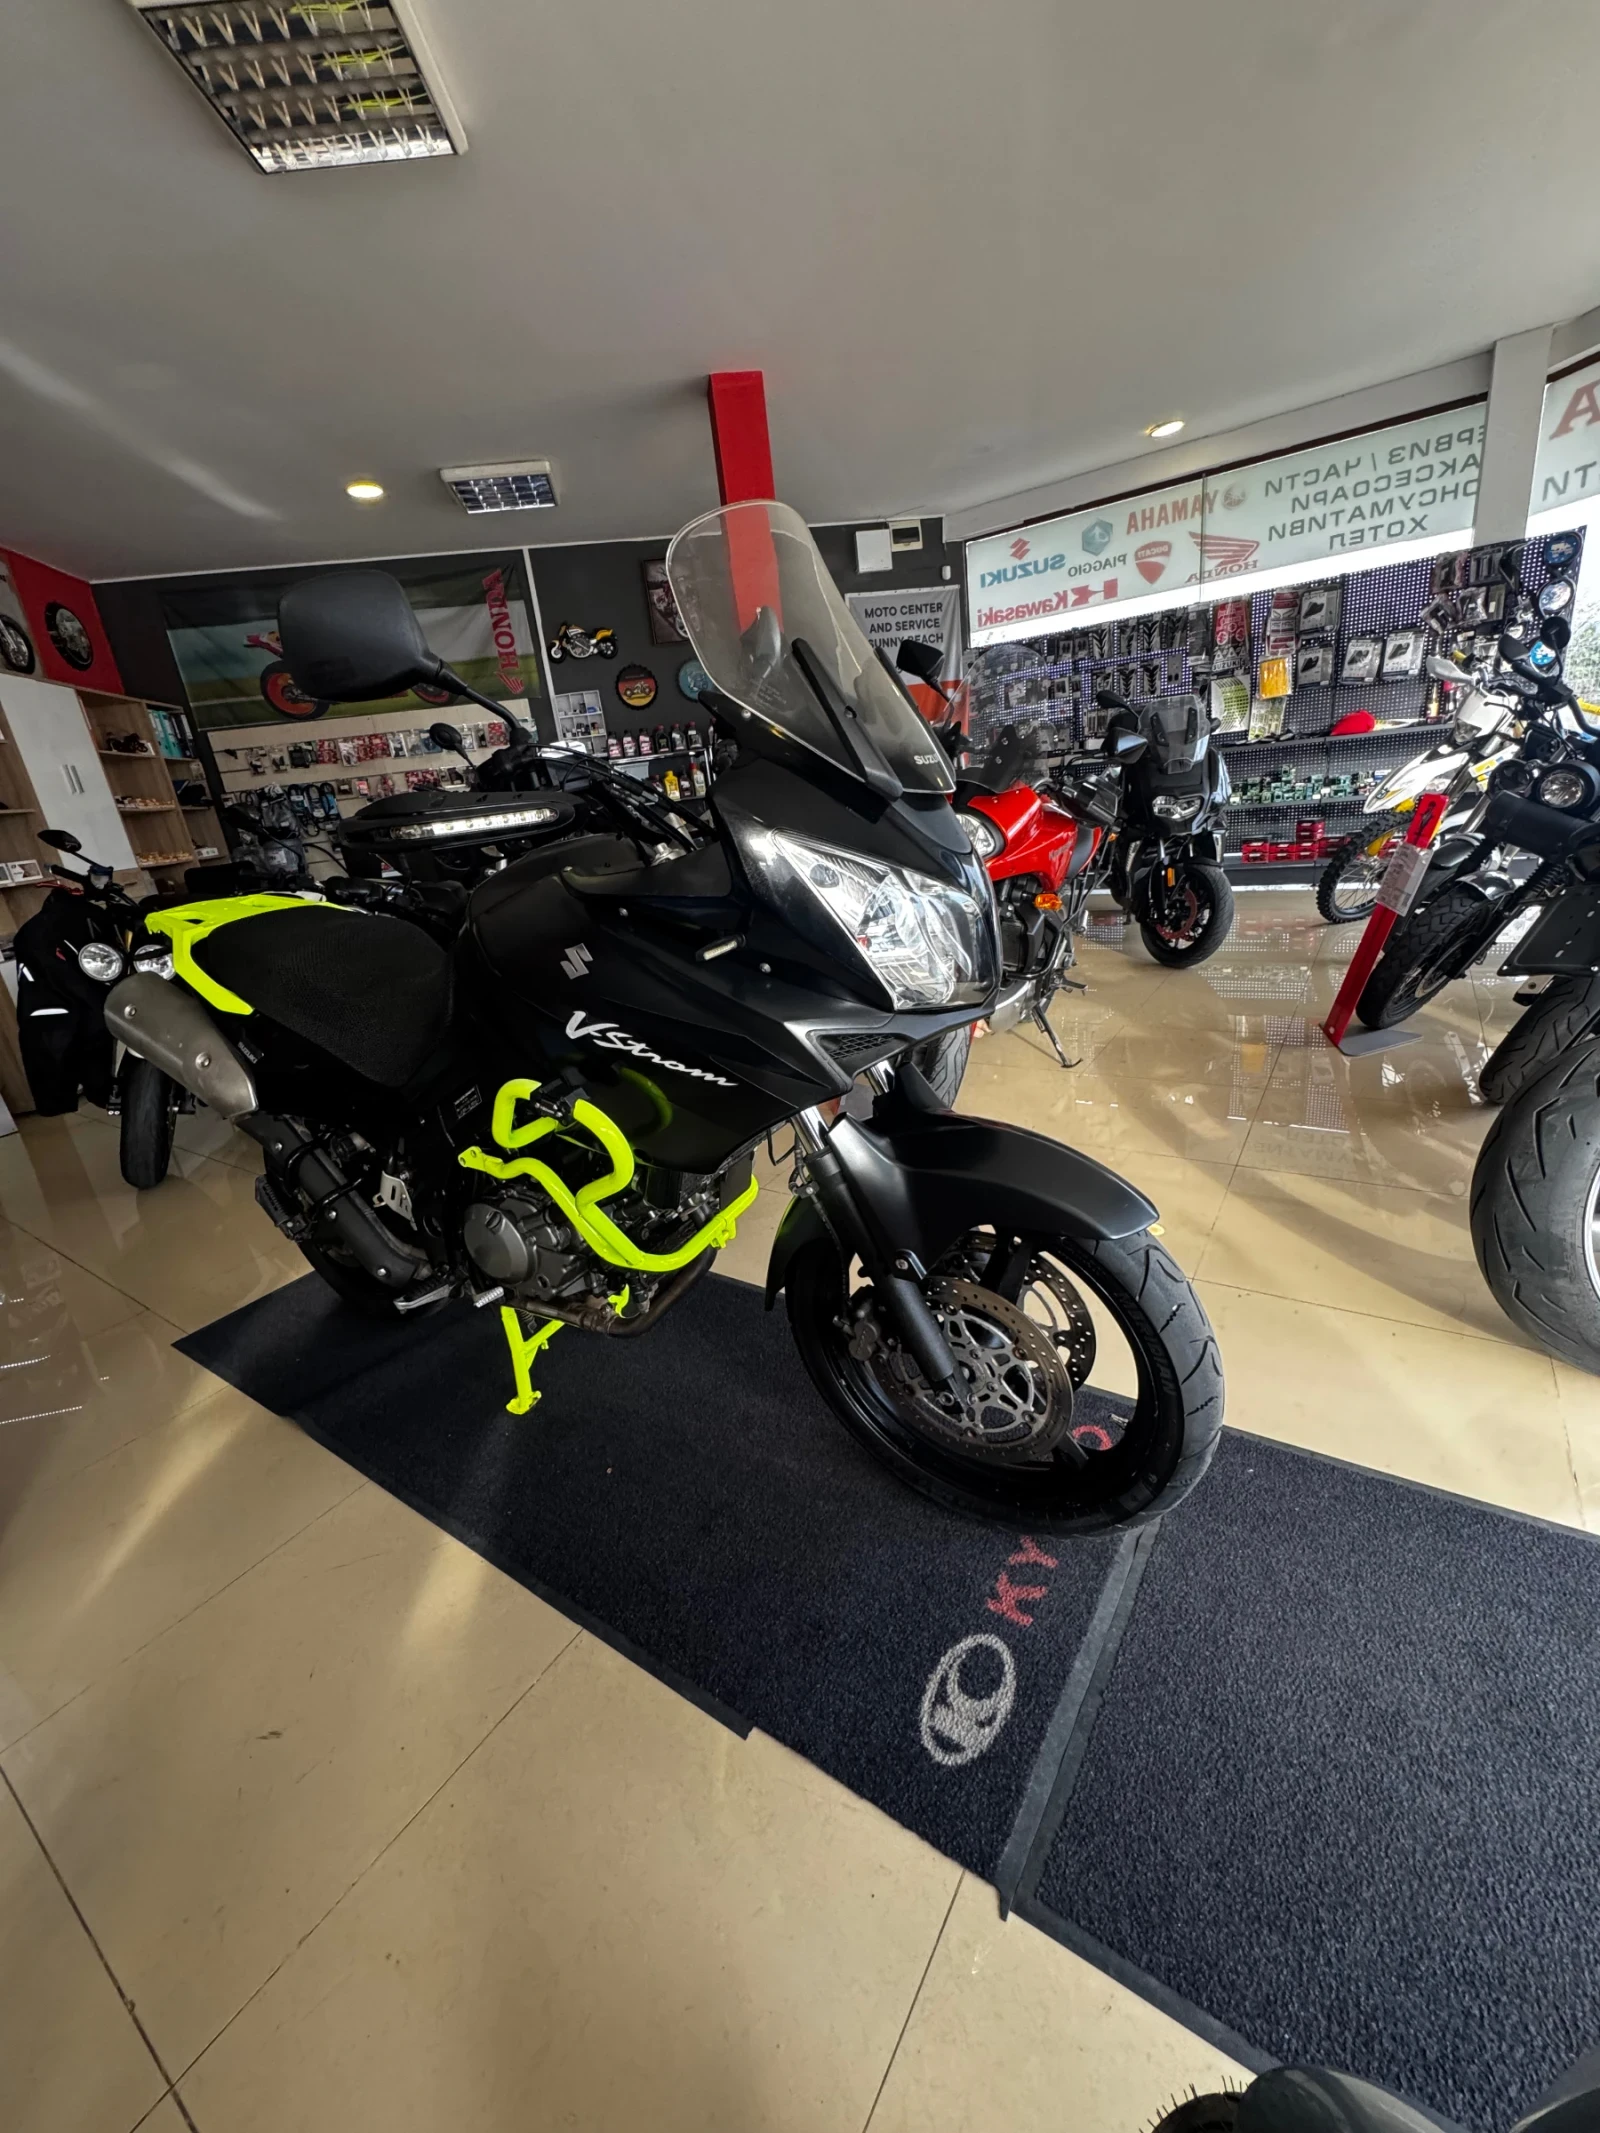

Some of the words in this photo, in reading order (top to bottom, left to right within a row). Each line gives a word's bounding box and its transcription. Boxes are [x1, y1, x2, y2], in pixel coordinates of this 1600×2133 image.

[864, 606, 897, 619] MOTO
[900, 602, 943, 616] CENTER
[869, 622, 892, 634] AND
[895, 618, 941, 632] SERVICE
